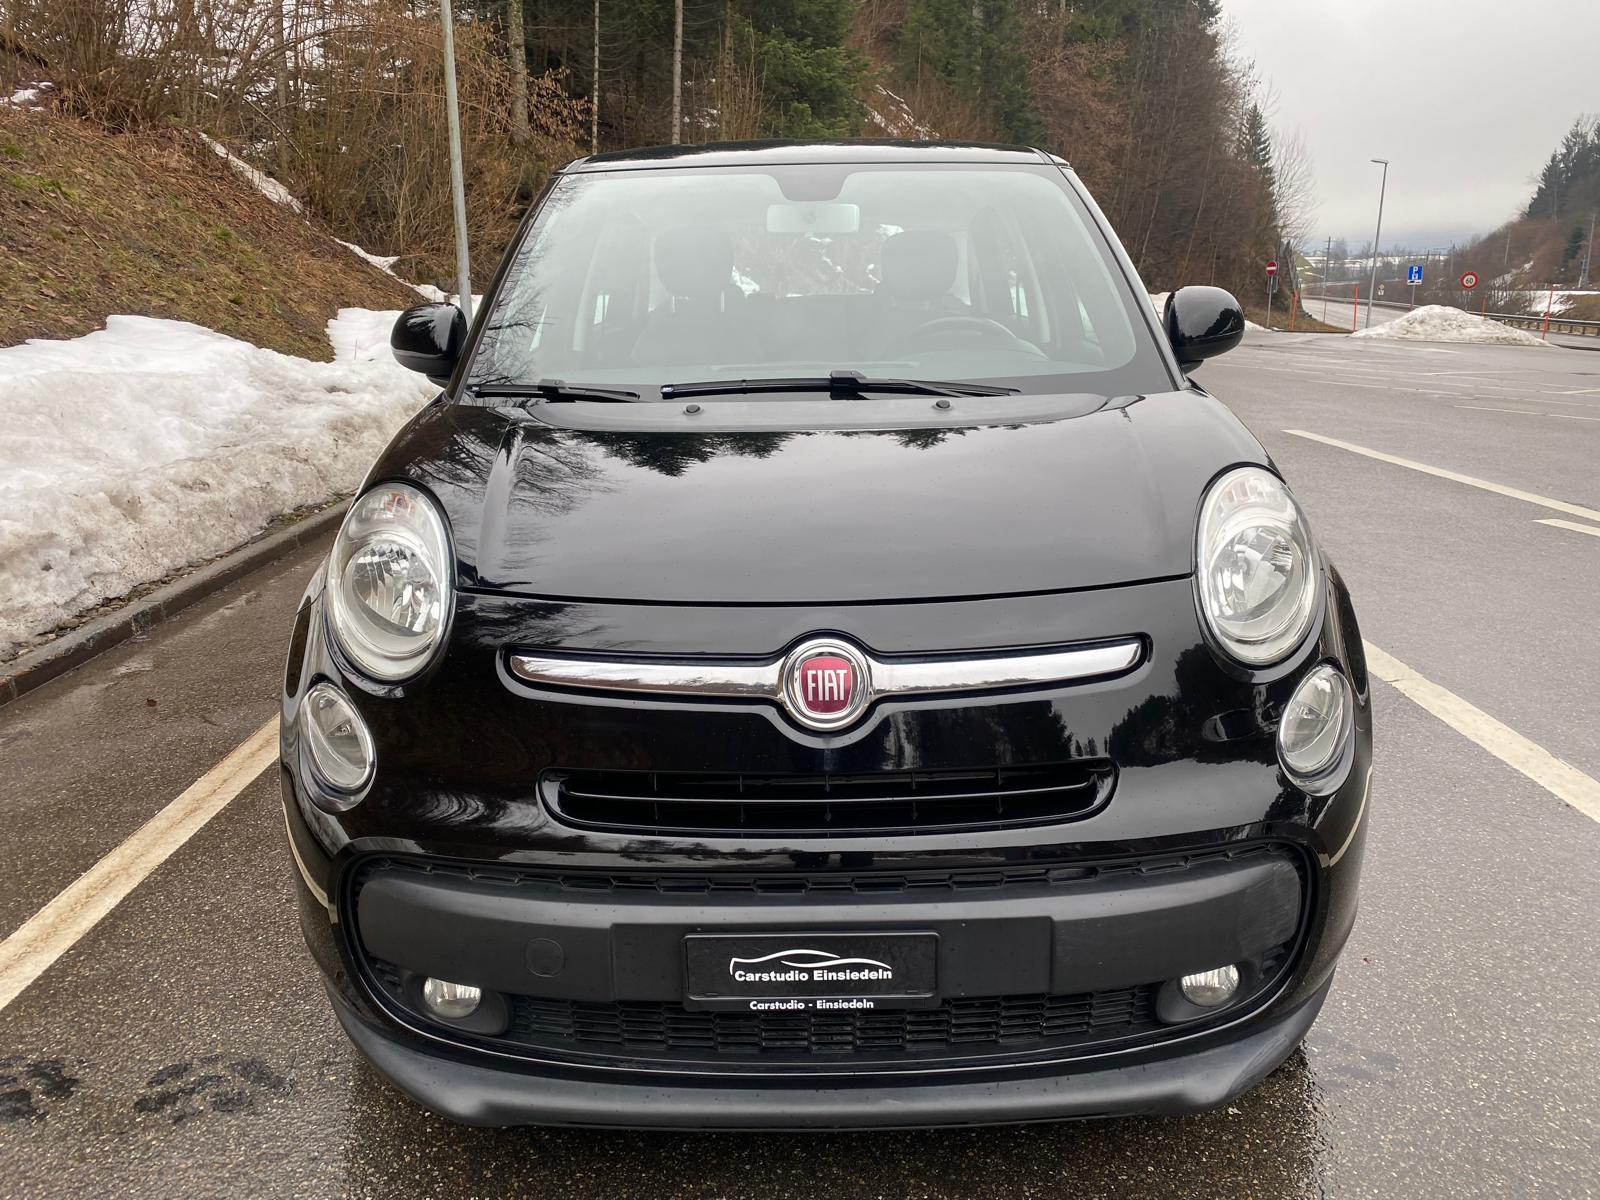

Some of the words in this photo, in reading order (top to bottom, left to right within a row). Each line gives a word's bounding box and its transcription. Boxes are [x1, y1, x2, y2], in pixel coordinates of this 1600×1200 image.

[1465, 277, 1474, 285] 60
[807, 669, 848, 702] FIAT
[734, 970, 809, 982] Carstudio
[813, 968, 893, 981] Einsiedeln
[749, 1000, 806, 1010] Carstudio
[816, 998, 874, 1010] Einsiedeln
